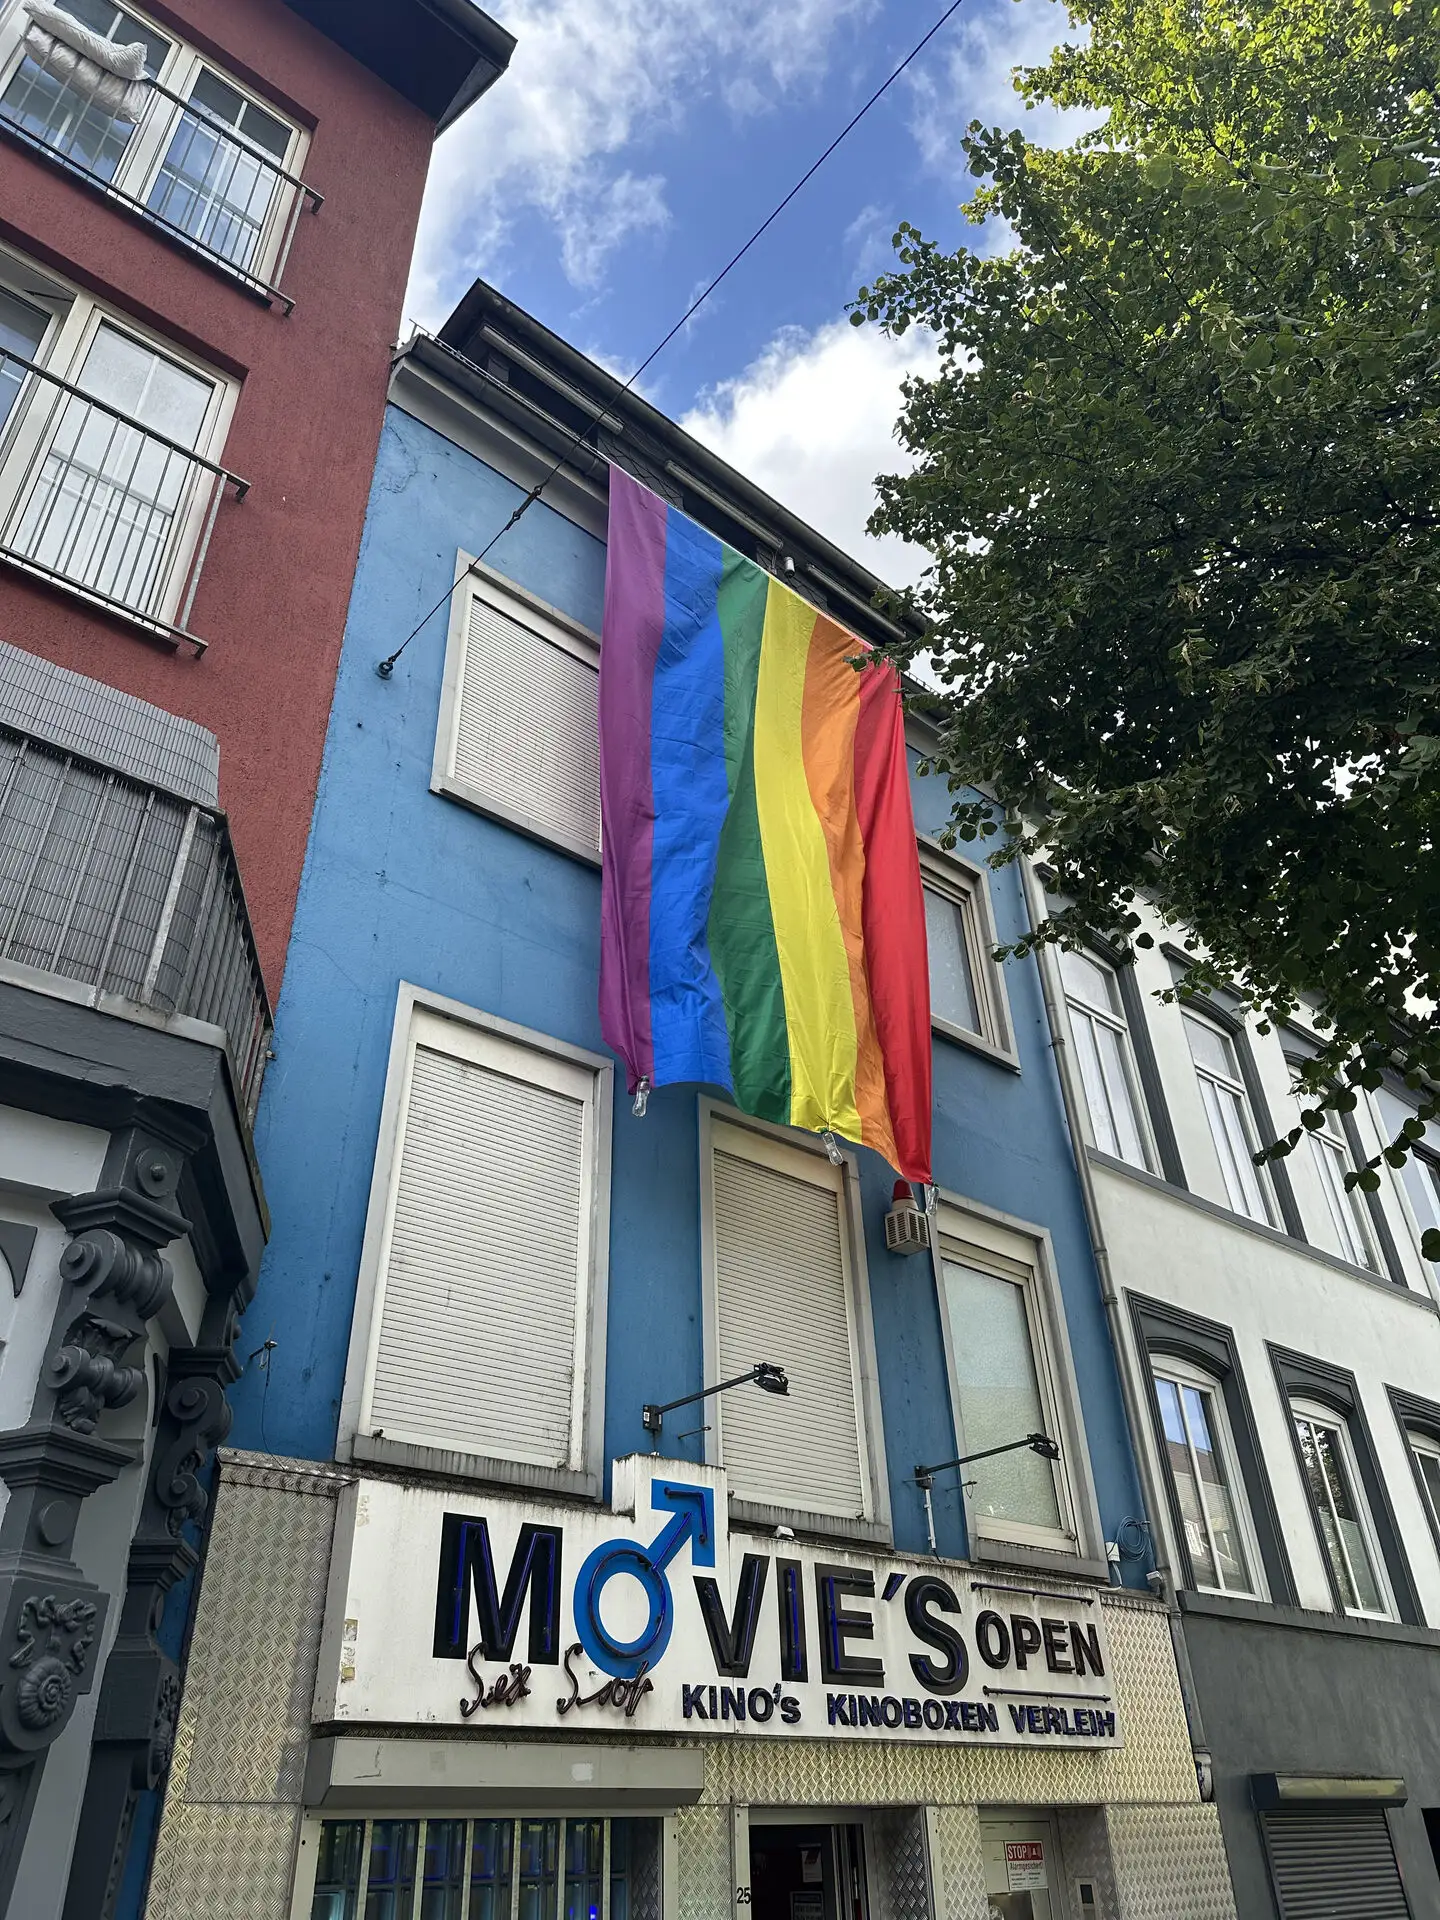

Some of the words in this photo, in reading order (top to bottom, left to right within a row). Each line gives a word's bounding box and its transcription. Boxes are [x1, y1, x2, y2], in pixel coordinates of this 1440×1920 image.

[433, 1478, 969, 1695] MOVIE'S
[975, 1610, 1105, 1676] OPEN
[682, 1682, 802, 1723] KINO's
[827, 1693, 999, 1731] KINOBOXEN
[1007, 1703, 1115, 1737] VERLEIH
[1007, 1845, 1027, 1859] STOP
[736, 1887, 751, 1904] 25
